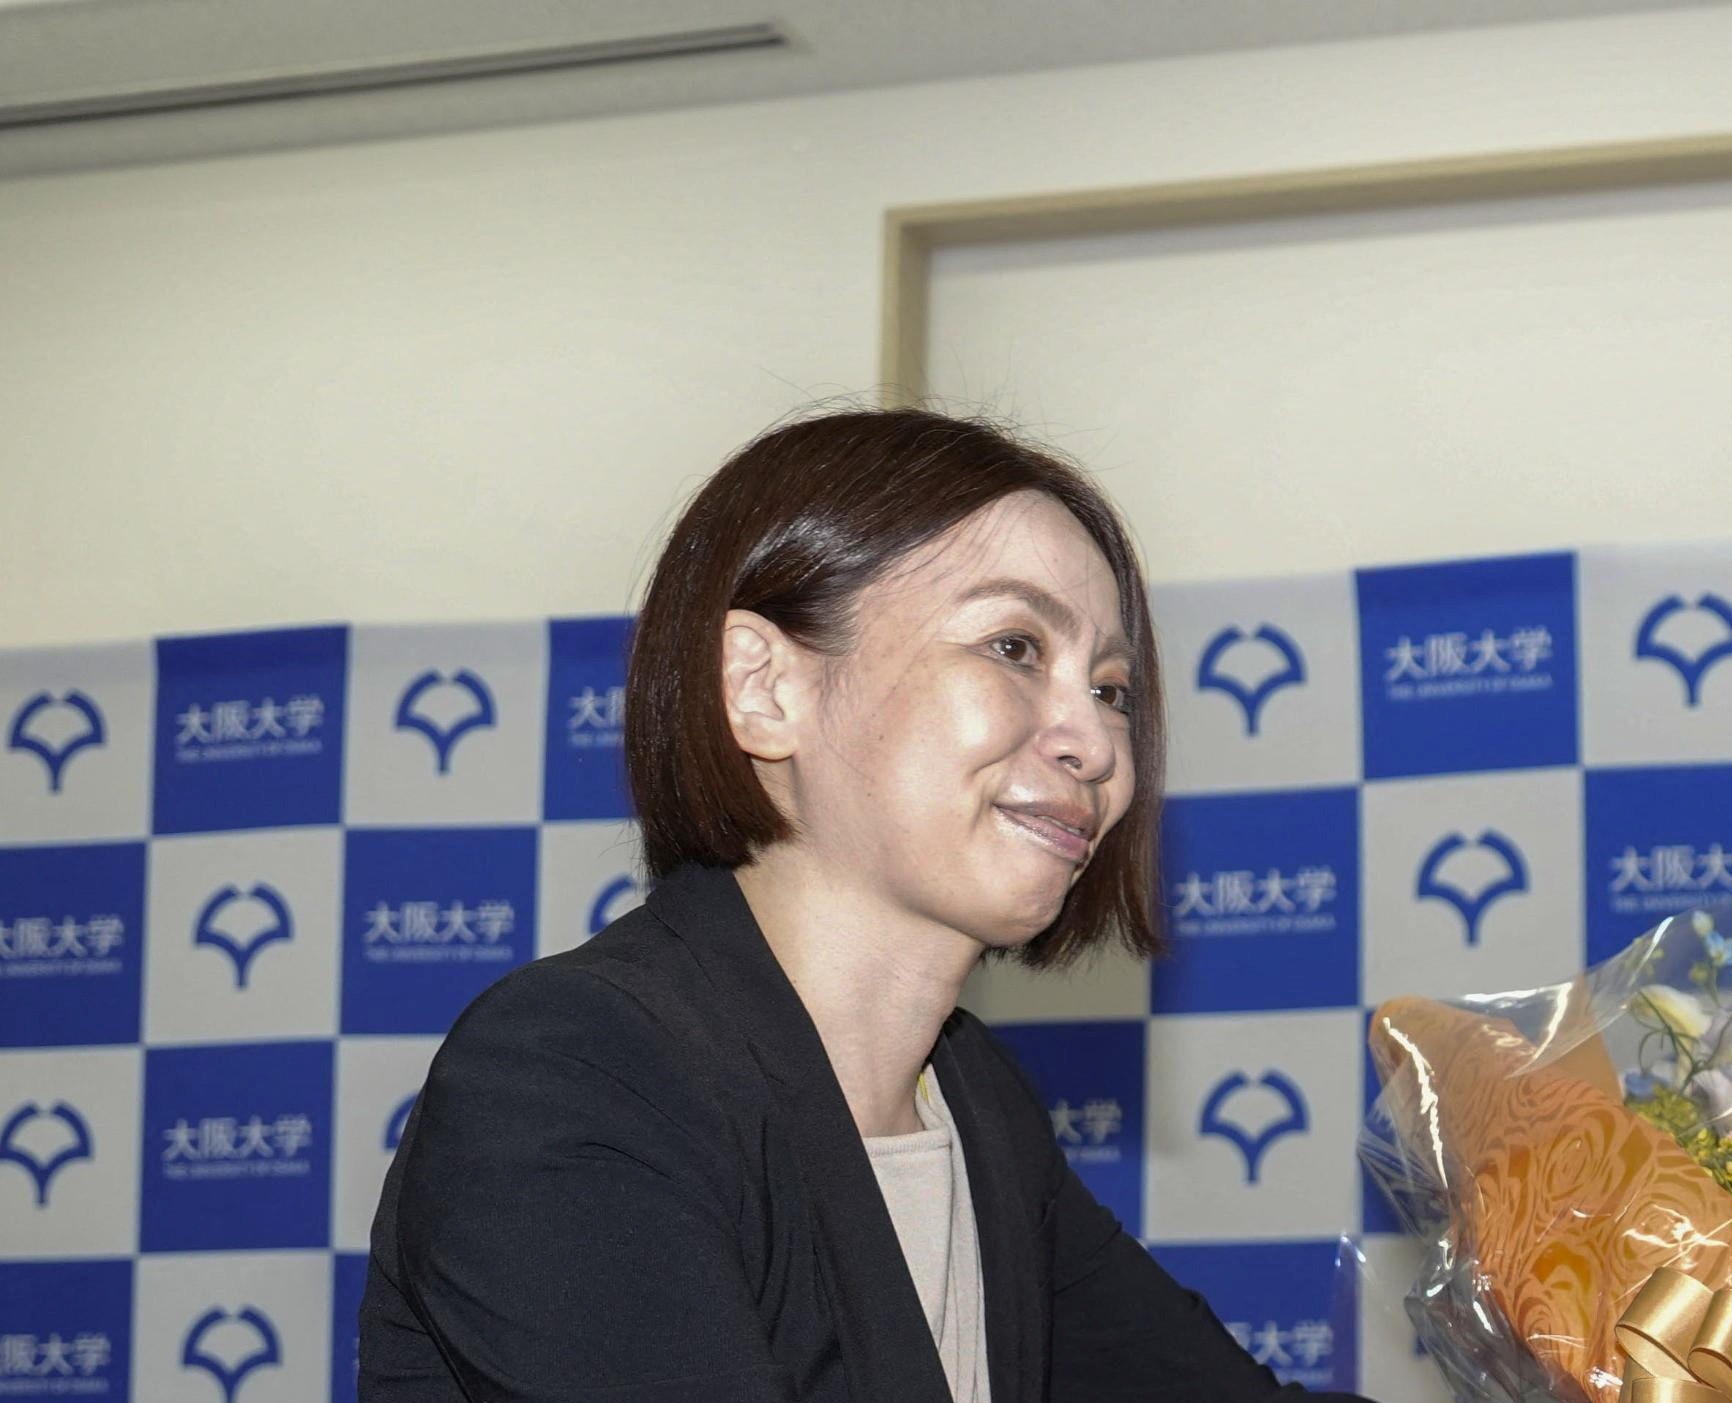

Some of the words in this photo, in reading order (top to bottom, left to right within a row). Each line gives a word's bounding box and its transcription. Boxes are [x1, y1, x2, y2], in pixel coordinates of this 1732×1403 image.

[1384, 625, 1552, 682] 大阪大学
[175, 696, 324, 745] 大阪大学
[1173, 866, 1336, 918] 大阪大学
[363, 900, 515, 945] 大阪大学
[162, 1114, 312, 1161] 大阪大学
[1048, 1098, 1122, 1143] 大学
[0, 1332, 111, 1377] 阪大学
